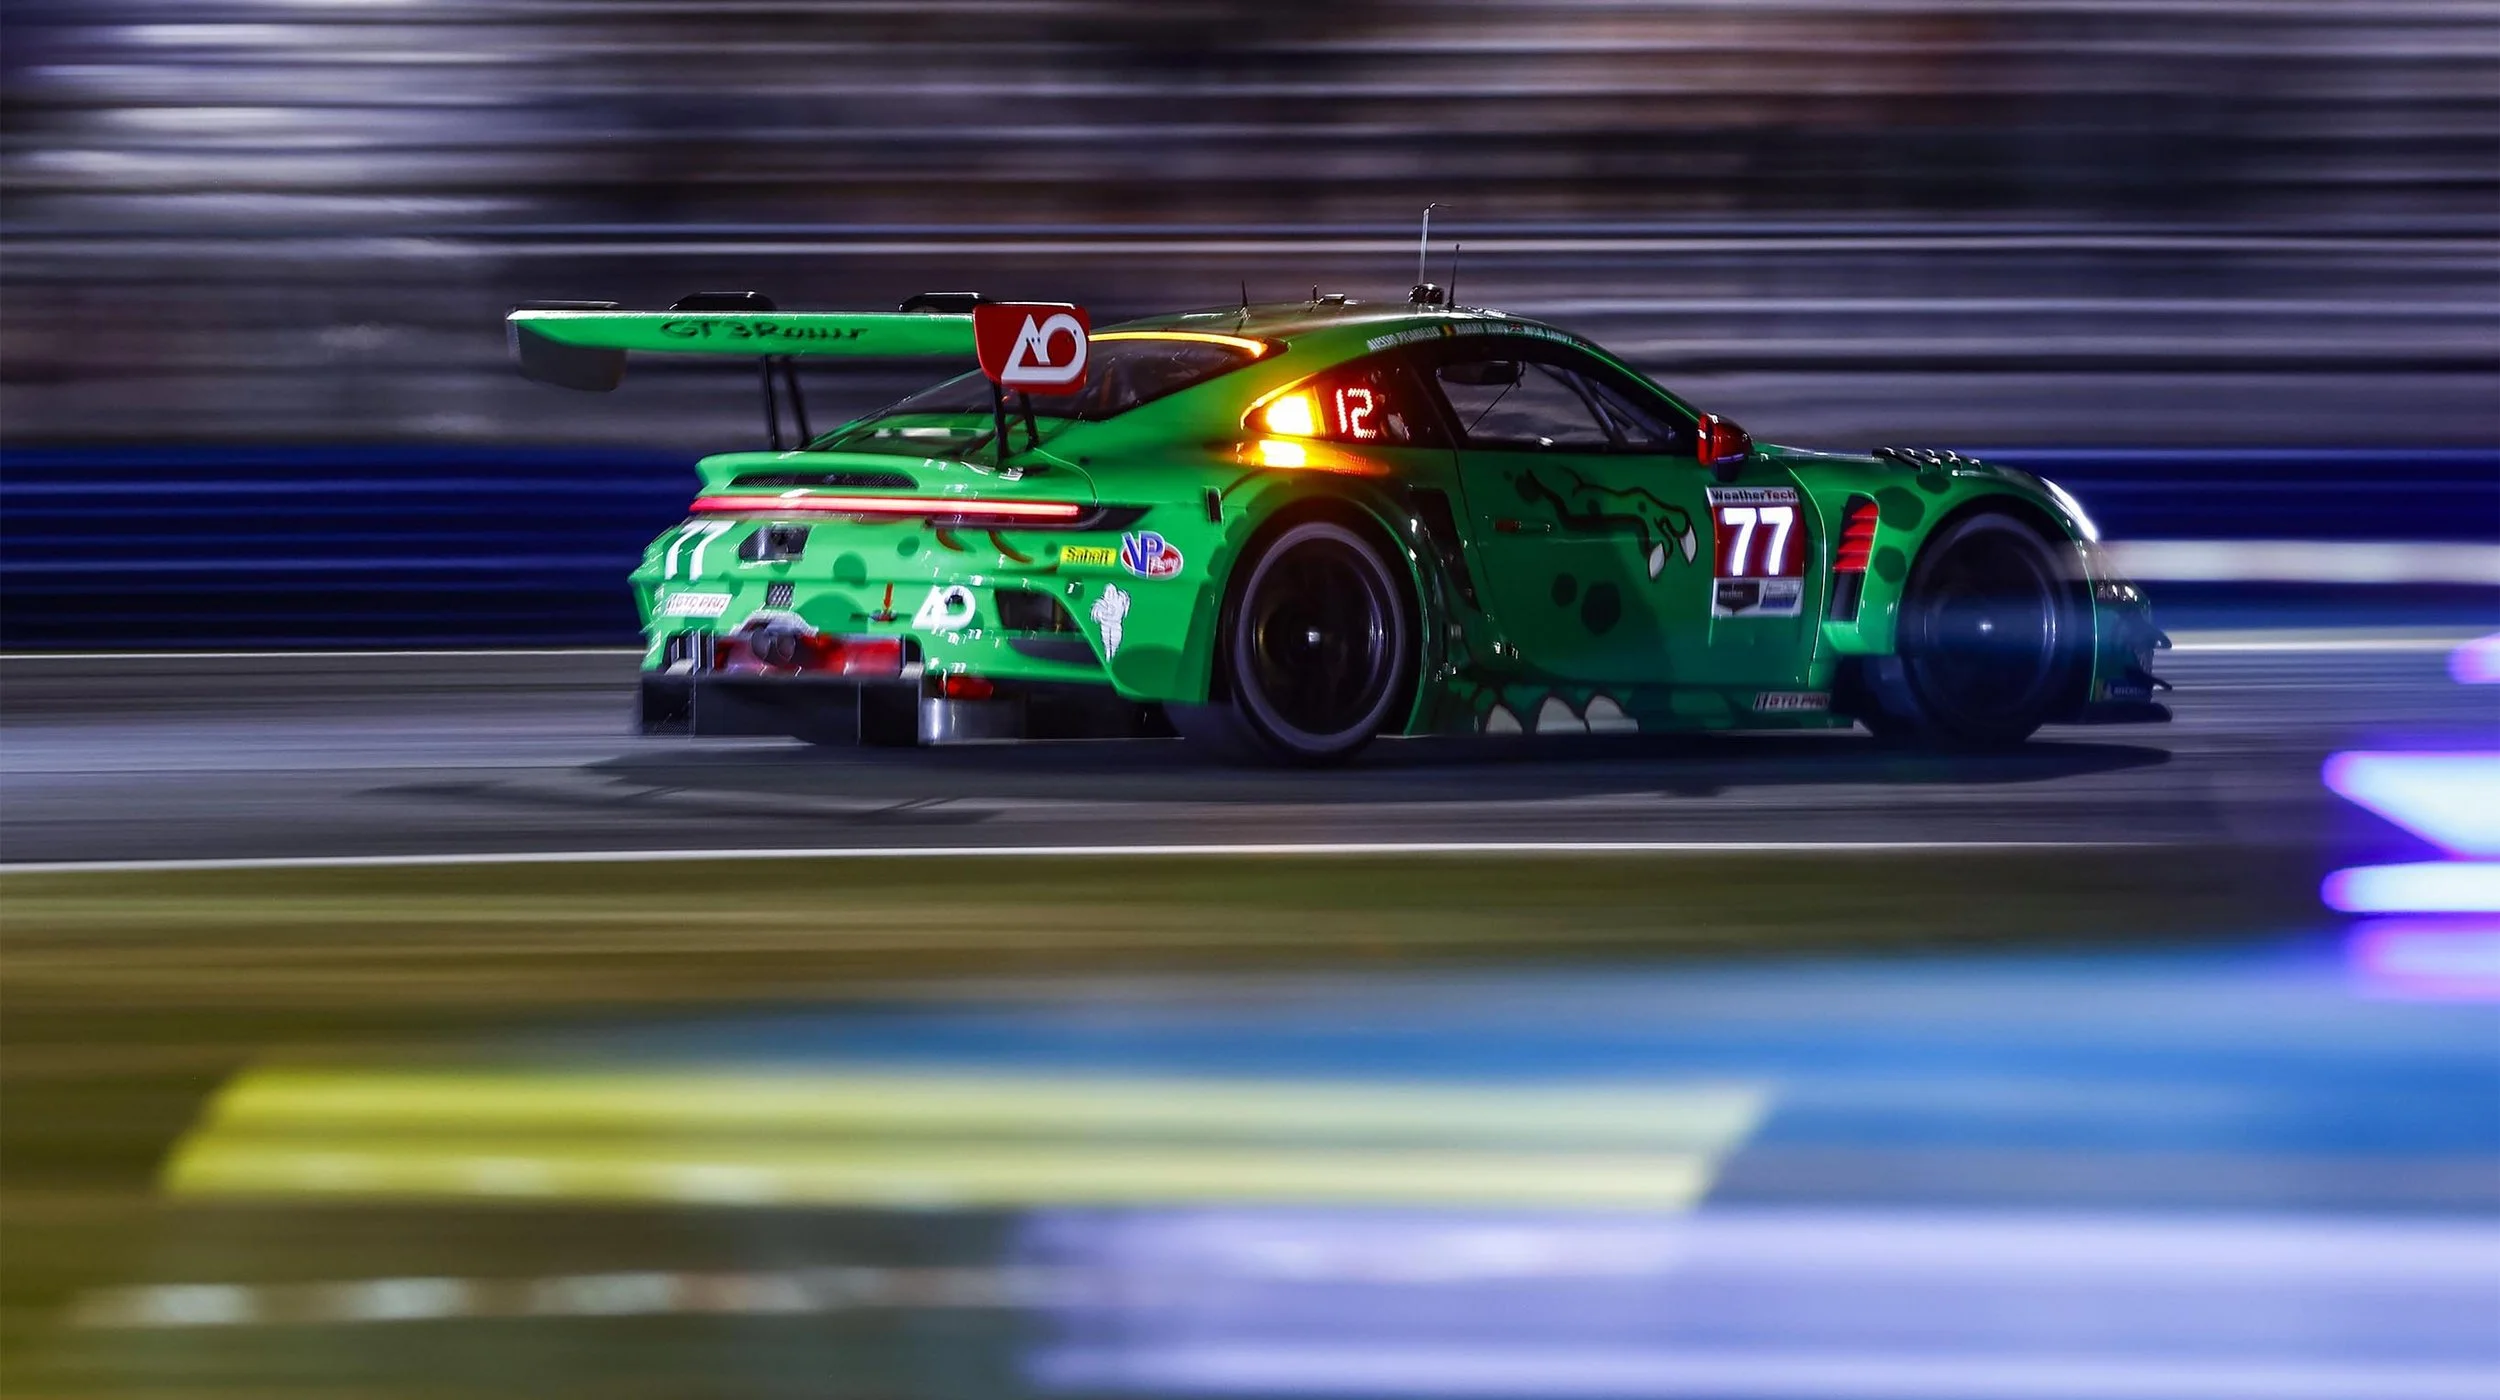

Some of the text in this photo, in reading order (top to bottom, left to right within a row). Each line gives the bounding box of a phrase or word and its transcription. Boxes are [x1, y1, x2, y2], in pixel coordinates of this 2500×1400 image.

[1336, 388, 1376, 438] 12
[1711, 488, 1797, 501] WeatherTech
[664, 520, 737, 581] 77
[1121, 530, 1165, 578] VP
[1723, 506, 1793, 577] 77
